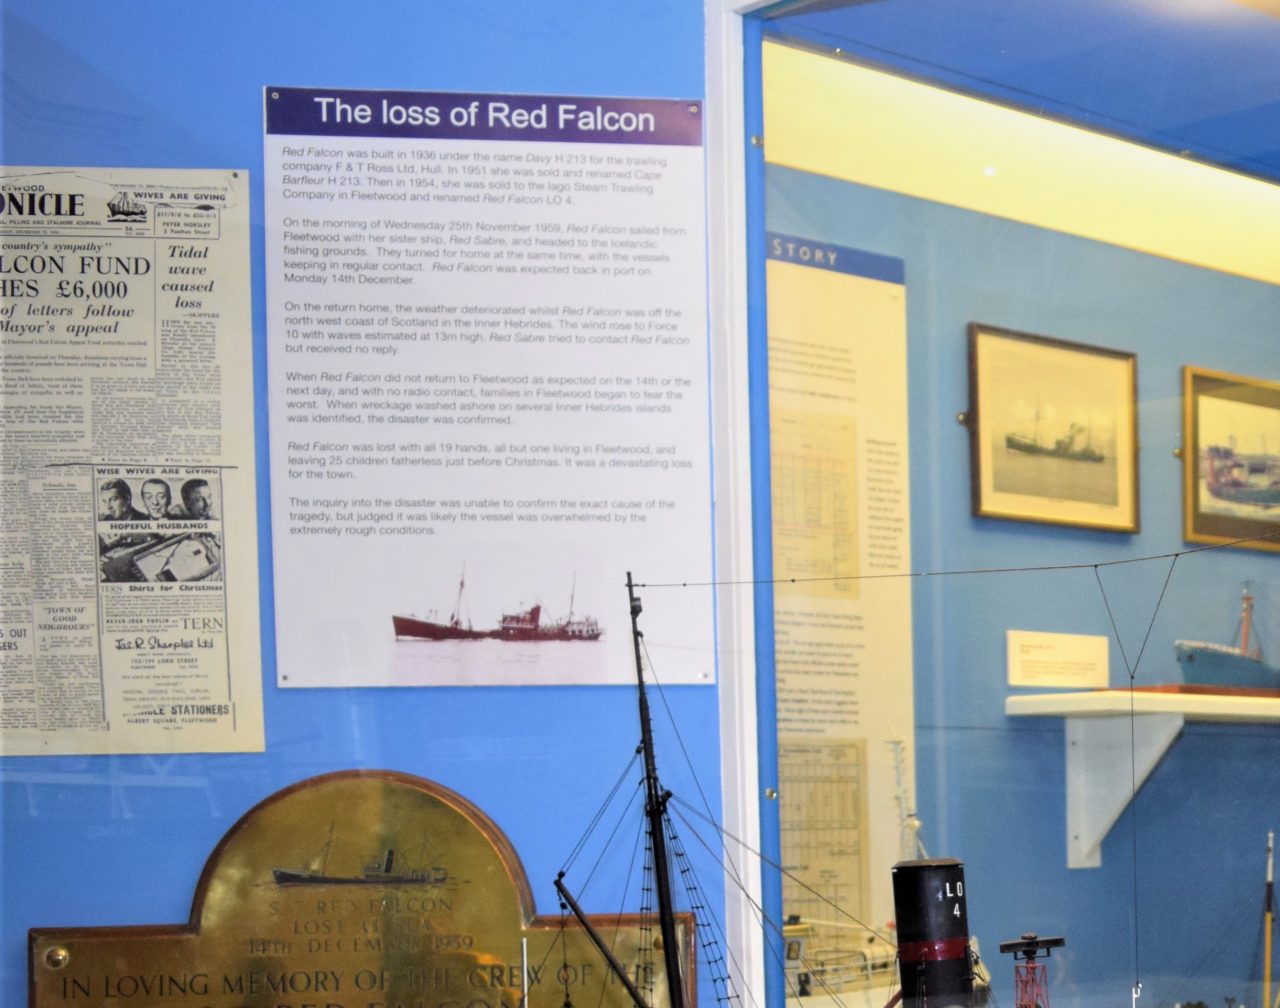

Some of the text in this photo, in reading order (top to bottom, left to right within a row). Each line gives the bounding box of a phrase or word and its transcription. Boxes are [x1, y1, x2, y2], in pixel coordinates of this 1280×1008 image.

[314, 97, 655, 132] The loss of Red Falcon
[282, 147, 304, 157] Red
[307, 148, 343, 158] Falcon
[372, 149, 393, 159] built
[398, 150, 406, 159] in
[411, 151, 435, 160] 1936
[440, 151, 469, 160] under
[474, 153, 489, 161] the
[526, 153, 551, 165] Davy
[555, 154, 563, 163] H
[567, 155, 586, 164] 213
[589, 155, 603, 164] for
[607, 156, 623, 165] the
[627, 157, 667, 167] trawling
[283, 218, 298, 227] On
[302, 218, 319, 228] the
[323, 219, 367, 230] morning
[370, 219, 380, 229] of
[384, 220, 445, 232] Wednesday
[449, 221, 472, 231] 25th
[476, 222, 530, 232] November
[567, 224, 589, 233] Red
[592, 224, 625, 234] Falcon
[630, 225, 659, 236] sailed
[663, 226, 686, 236] from
[2, 241, 48, 252] country's
[168, 245, 209, 258] Tidal
[773, 238, 837, 265] STORY
[80, 256, 150, 275] FUND
[169, 265, 206, 275] wave
[56, 280, 128, 301] £6,000
[162, 281, 214, 292] caused
[175, 295, 202, 308] loss
[0, 304, 134, 319] of letters follow
[66, 321, 119, 336] appeal
[180, 618, 223, 630] TERN
[10, 629, 27, 638] OUT
[171, 705, 229, 716] STATIONERS
[944, 881, 964, 898] LO
[953, 903, 961, 918] 4
[295, 921, 343, 935] LOST
[62, 977, 91, 999] IN
[104, 973, 209, 997] LOVING
[222, 970, 345, 995] MEMORY
[355, 970, 393, 991] OF
[468, 965, 544, 987] CREW
[557, 964, 593, 986] OF
